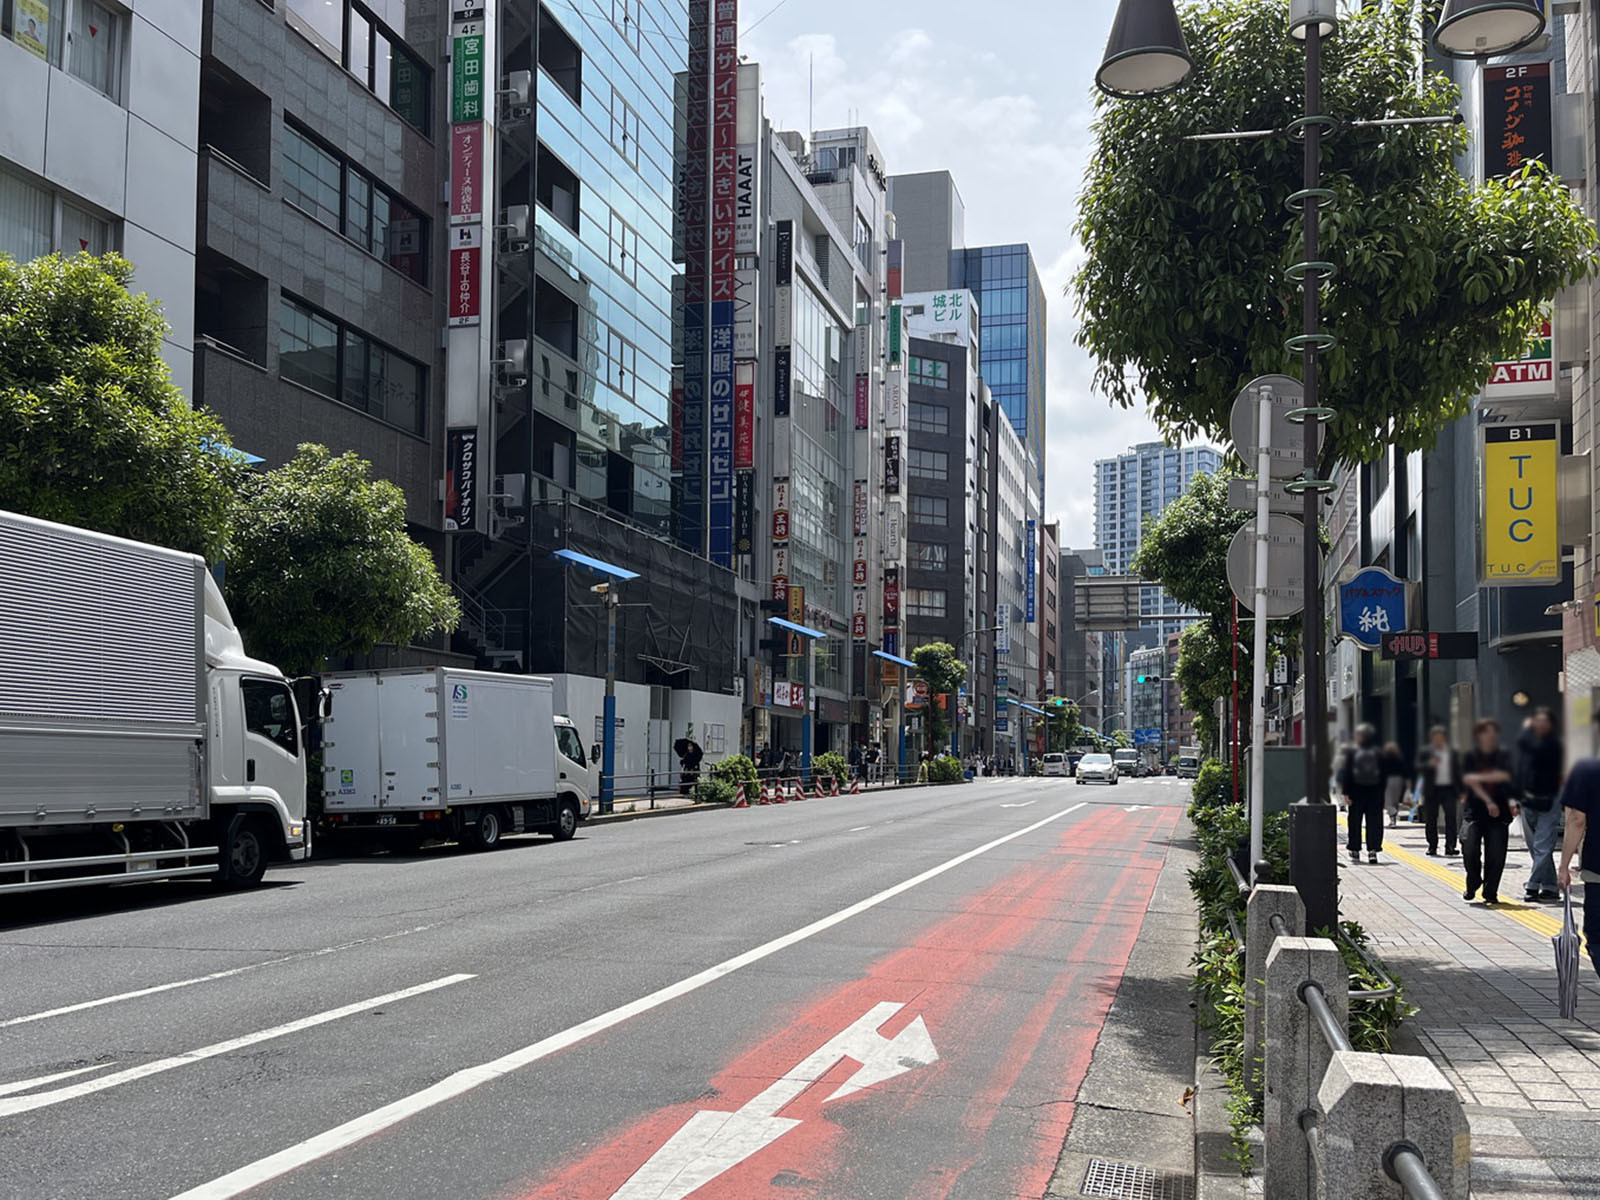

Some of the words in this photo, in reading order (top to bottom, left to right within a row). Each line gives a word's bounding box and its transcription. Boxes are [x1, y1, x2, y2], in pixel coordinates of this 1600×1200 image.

[462, 25, 476, 34] 4F
[463, 39, 479, 117] 宮田歯科
[1506, 67, 1528, 78] 2F
[738, 155, 753, 217] HAAAT
[460, 251, 470, 313] 長谷工の仲介
[932, 293, 963, 308] 城北
[934, 309, 962, 322] ビル
[1493, 364, 1548, 382] ATM
[712, 328, 731, 499] 洋服のサカゼン
[1509, 429, 1531, 439] B1
[461, 442, 473, 526] クロサワバイオリン
[1508, 455, 1534, 543] TUC
[890, 519, 898, 548] Hearth
[1358, 605, 1391, 633] 純
[1389, 635, 1427, 656] HUB
